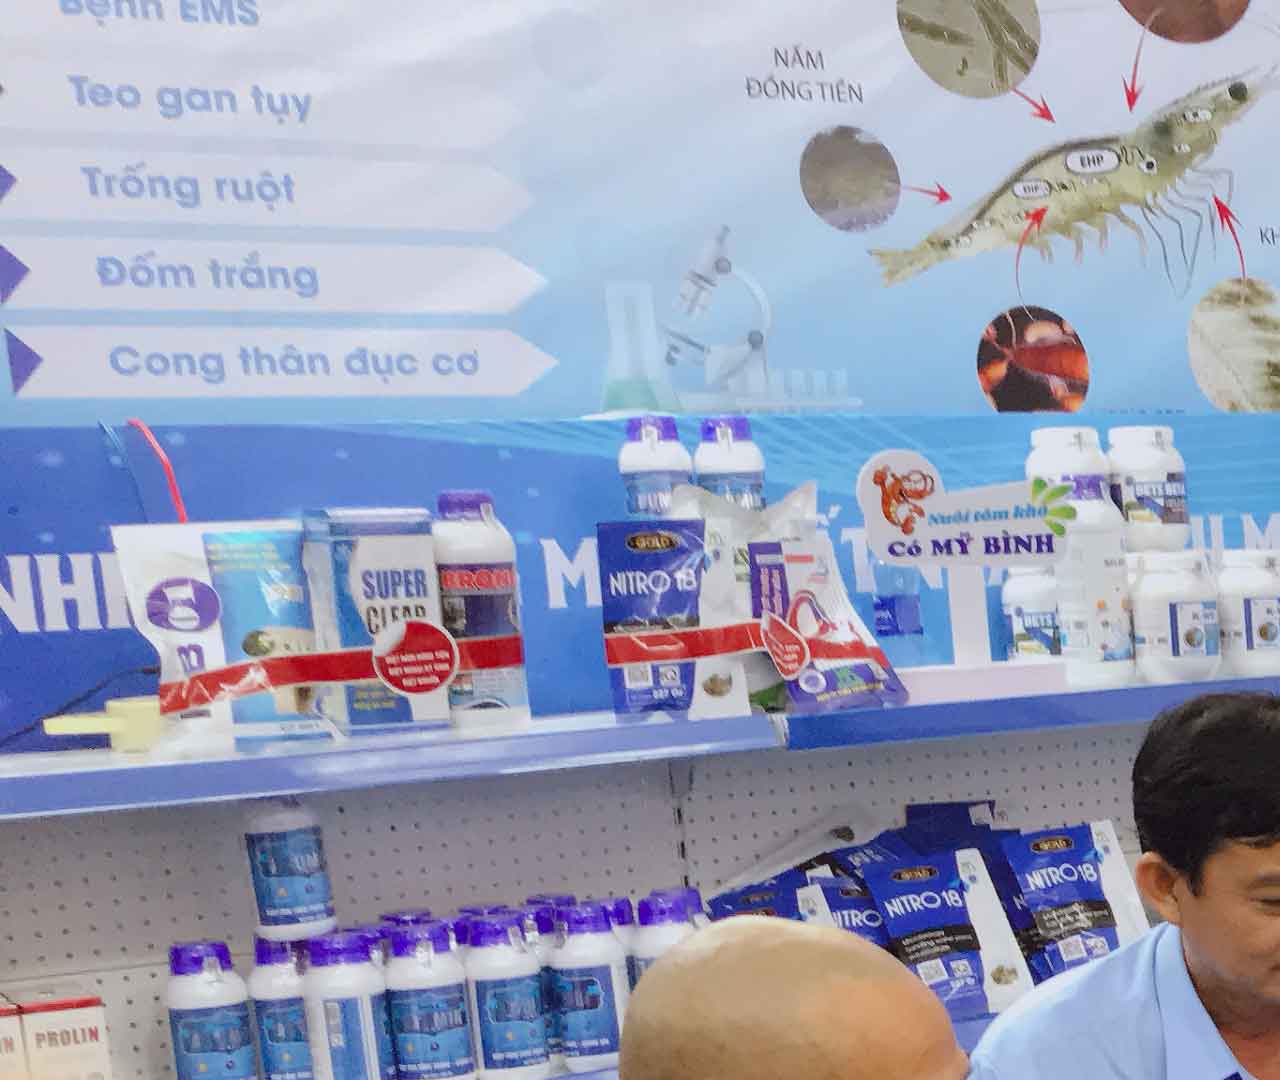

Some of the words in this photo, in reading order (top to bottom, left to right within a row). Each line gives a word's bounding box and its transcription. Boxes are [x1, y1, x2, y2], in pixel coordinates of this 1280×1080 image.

[180, 0, 260, 26] EMS
[67, 74, 141, 108] Teo
[156, 85, 237, 119] gan
[251, 85, 312, 124] tụy
[1079, 154, 1105, 169] EHP
[81, 162, 201, 208] Trống
[214, 174, 295, 211] ruột
[96, 252, 195, 289] Đốm
[208, 251, 320, 298] trắng
[109, 346, 225, 384] Cong
[239, 346, 330, 379] thân
[344, 347, 419, 383] đục
[431, 350, 480, 378] cơ
[888, 538, 922, 558] Có
[931, 531, 974, 556] MỸ
[984, 529, 1055, 554] BÌNH
[362, 567, 429, 599] SUPER
[610, 570, 671, 597] NITRO
[1027, 864, 1078, 891] NITRO
[1078, 863, 1098, 882] 18
[884, 891, 941, 919] NITRO
[944, 890, 963, 908] 18
[35, 1026, 100, 1049] PROLIN
